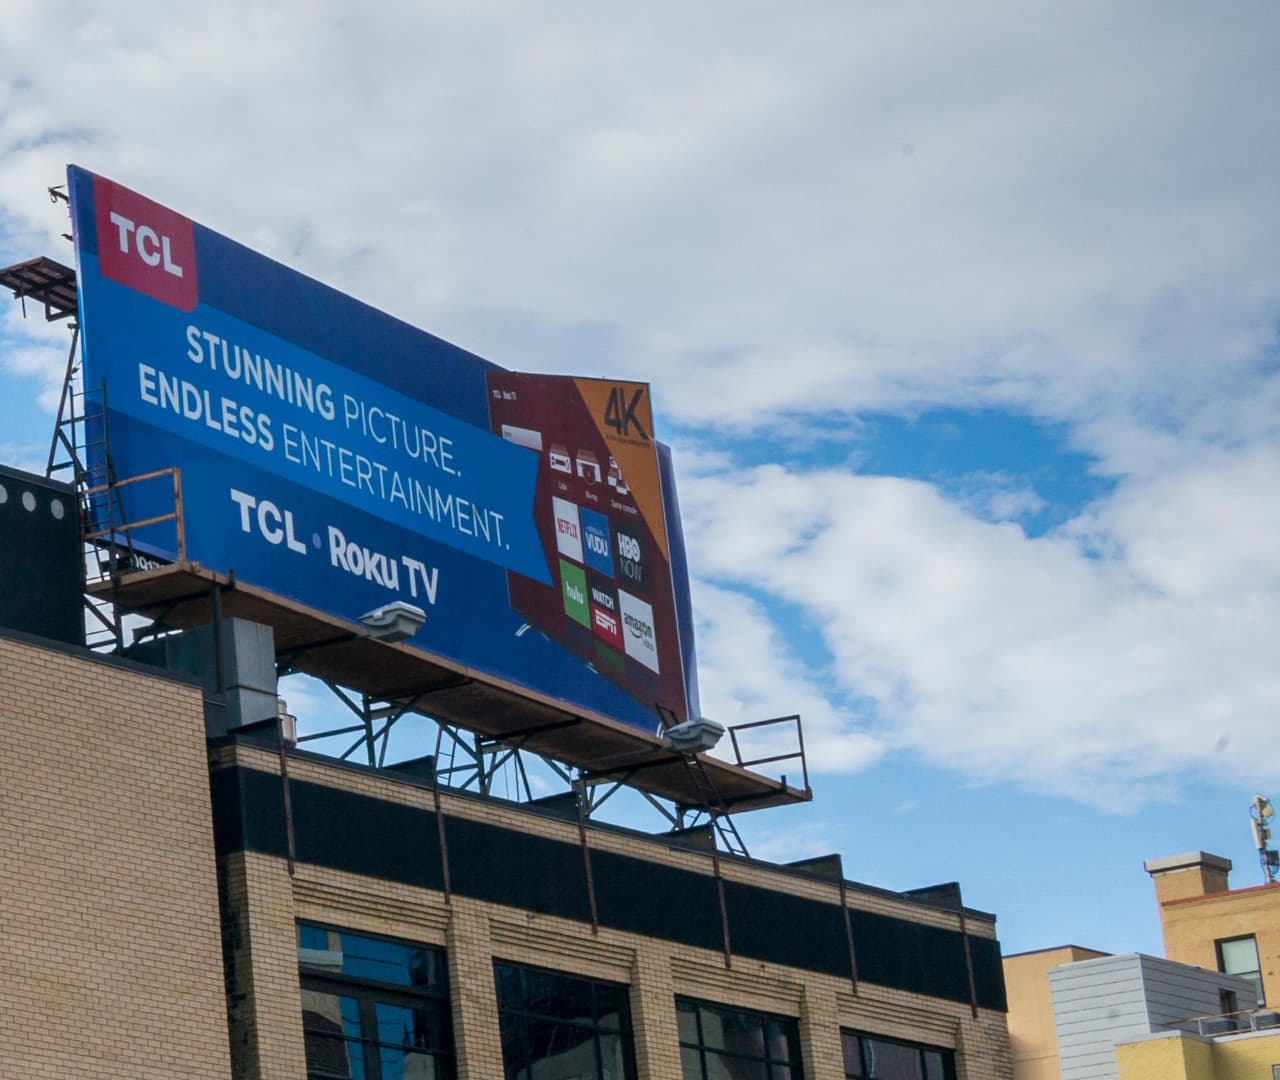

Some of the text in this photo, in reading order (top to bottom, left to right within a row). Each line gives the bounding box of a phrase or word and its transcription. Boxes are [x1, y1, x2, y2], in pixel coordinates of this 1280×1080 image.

[109, 211, 183, 278] TCL
[186, 325, 462, 477] STUNNING PICTURE.
[604, 386, 649, 440] 4K
[138, 362, 511, 551] ENDLESS ENTERTAINMENT.
[557, 518, 578, 541] NETFLIX
[230, 488, 307, 555] TCL
[402, 555, 439, 605] TV
[585, 532, 609, 557] VUDU
[617, 532, 640, 562] HBO
[620, 560, 643, 583] NOW
[565, 581, 584, 604] hulu
[592, 587, 615, 610] WATCH
[623, 611, 653, 640] amazon
